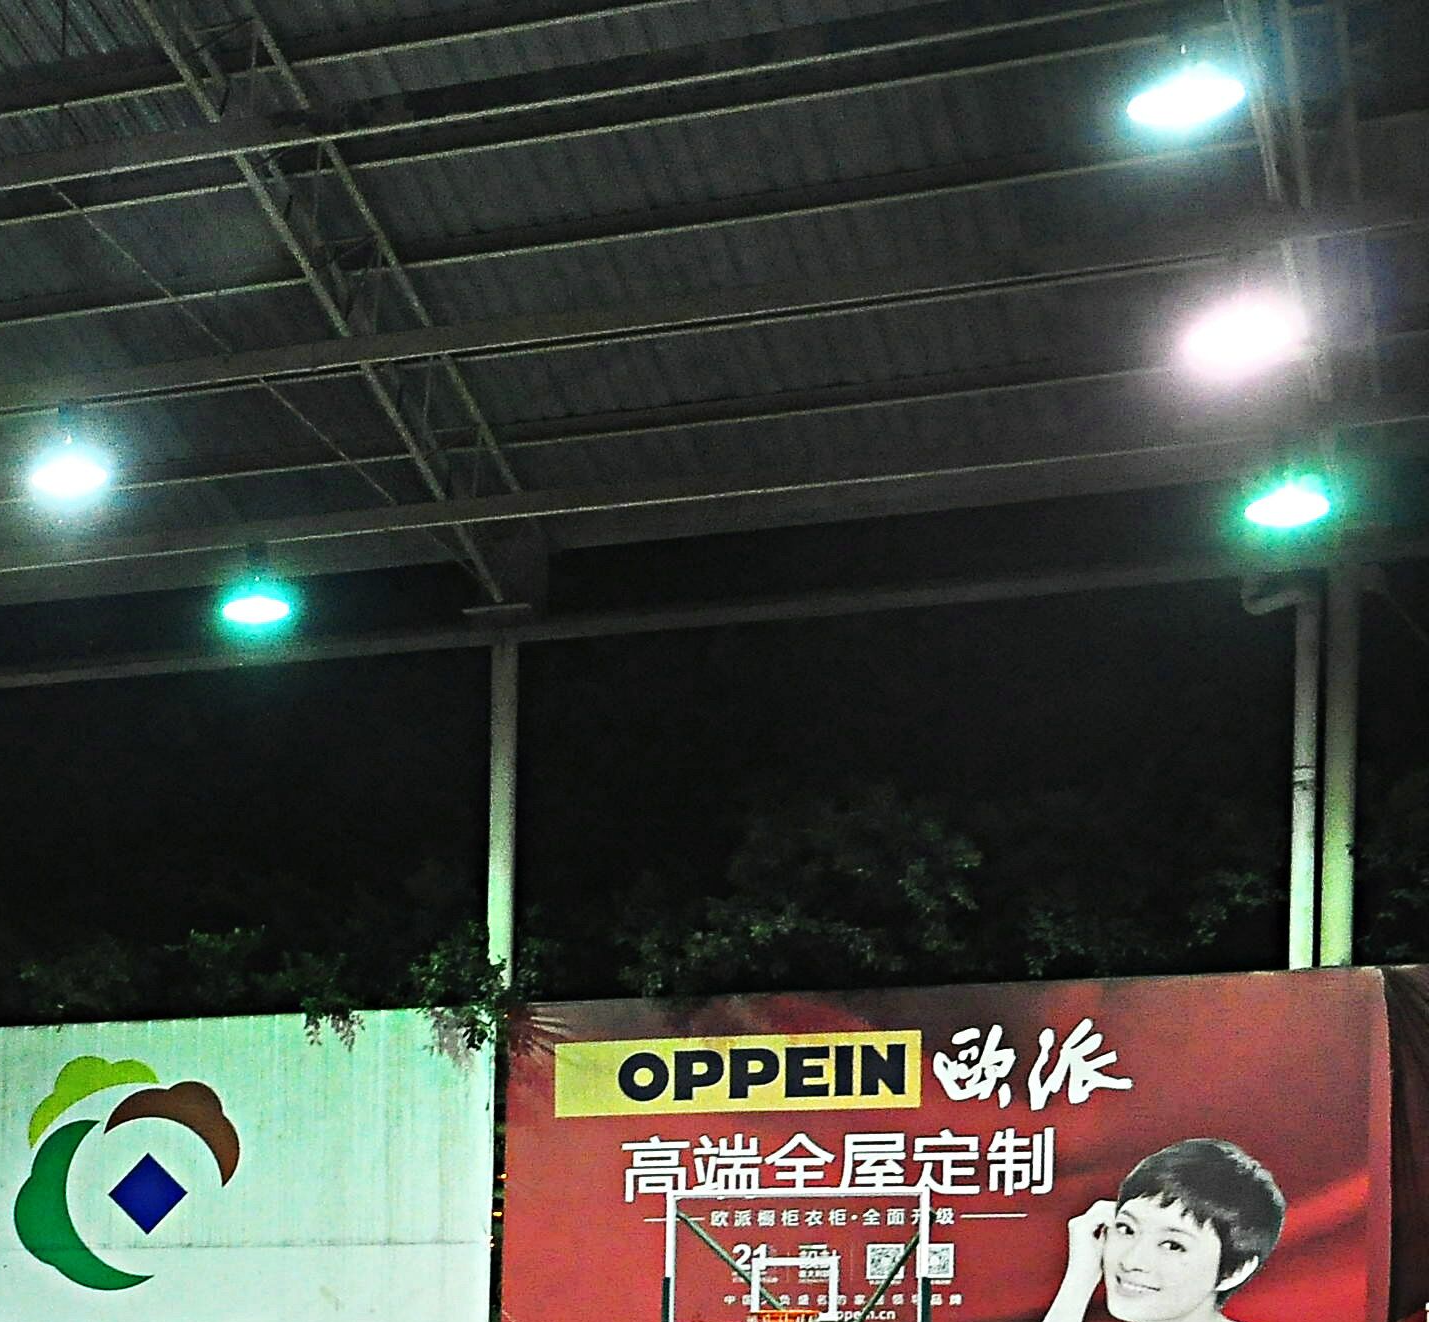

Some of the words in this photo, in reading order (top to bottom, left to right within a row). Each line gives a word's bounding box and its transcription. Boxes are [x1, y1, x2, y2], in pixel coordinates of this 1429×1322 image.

[617, 1042, 908, 1103] OPPEIN
[620, 1127, 1056, 1204] 高端全屋定制
